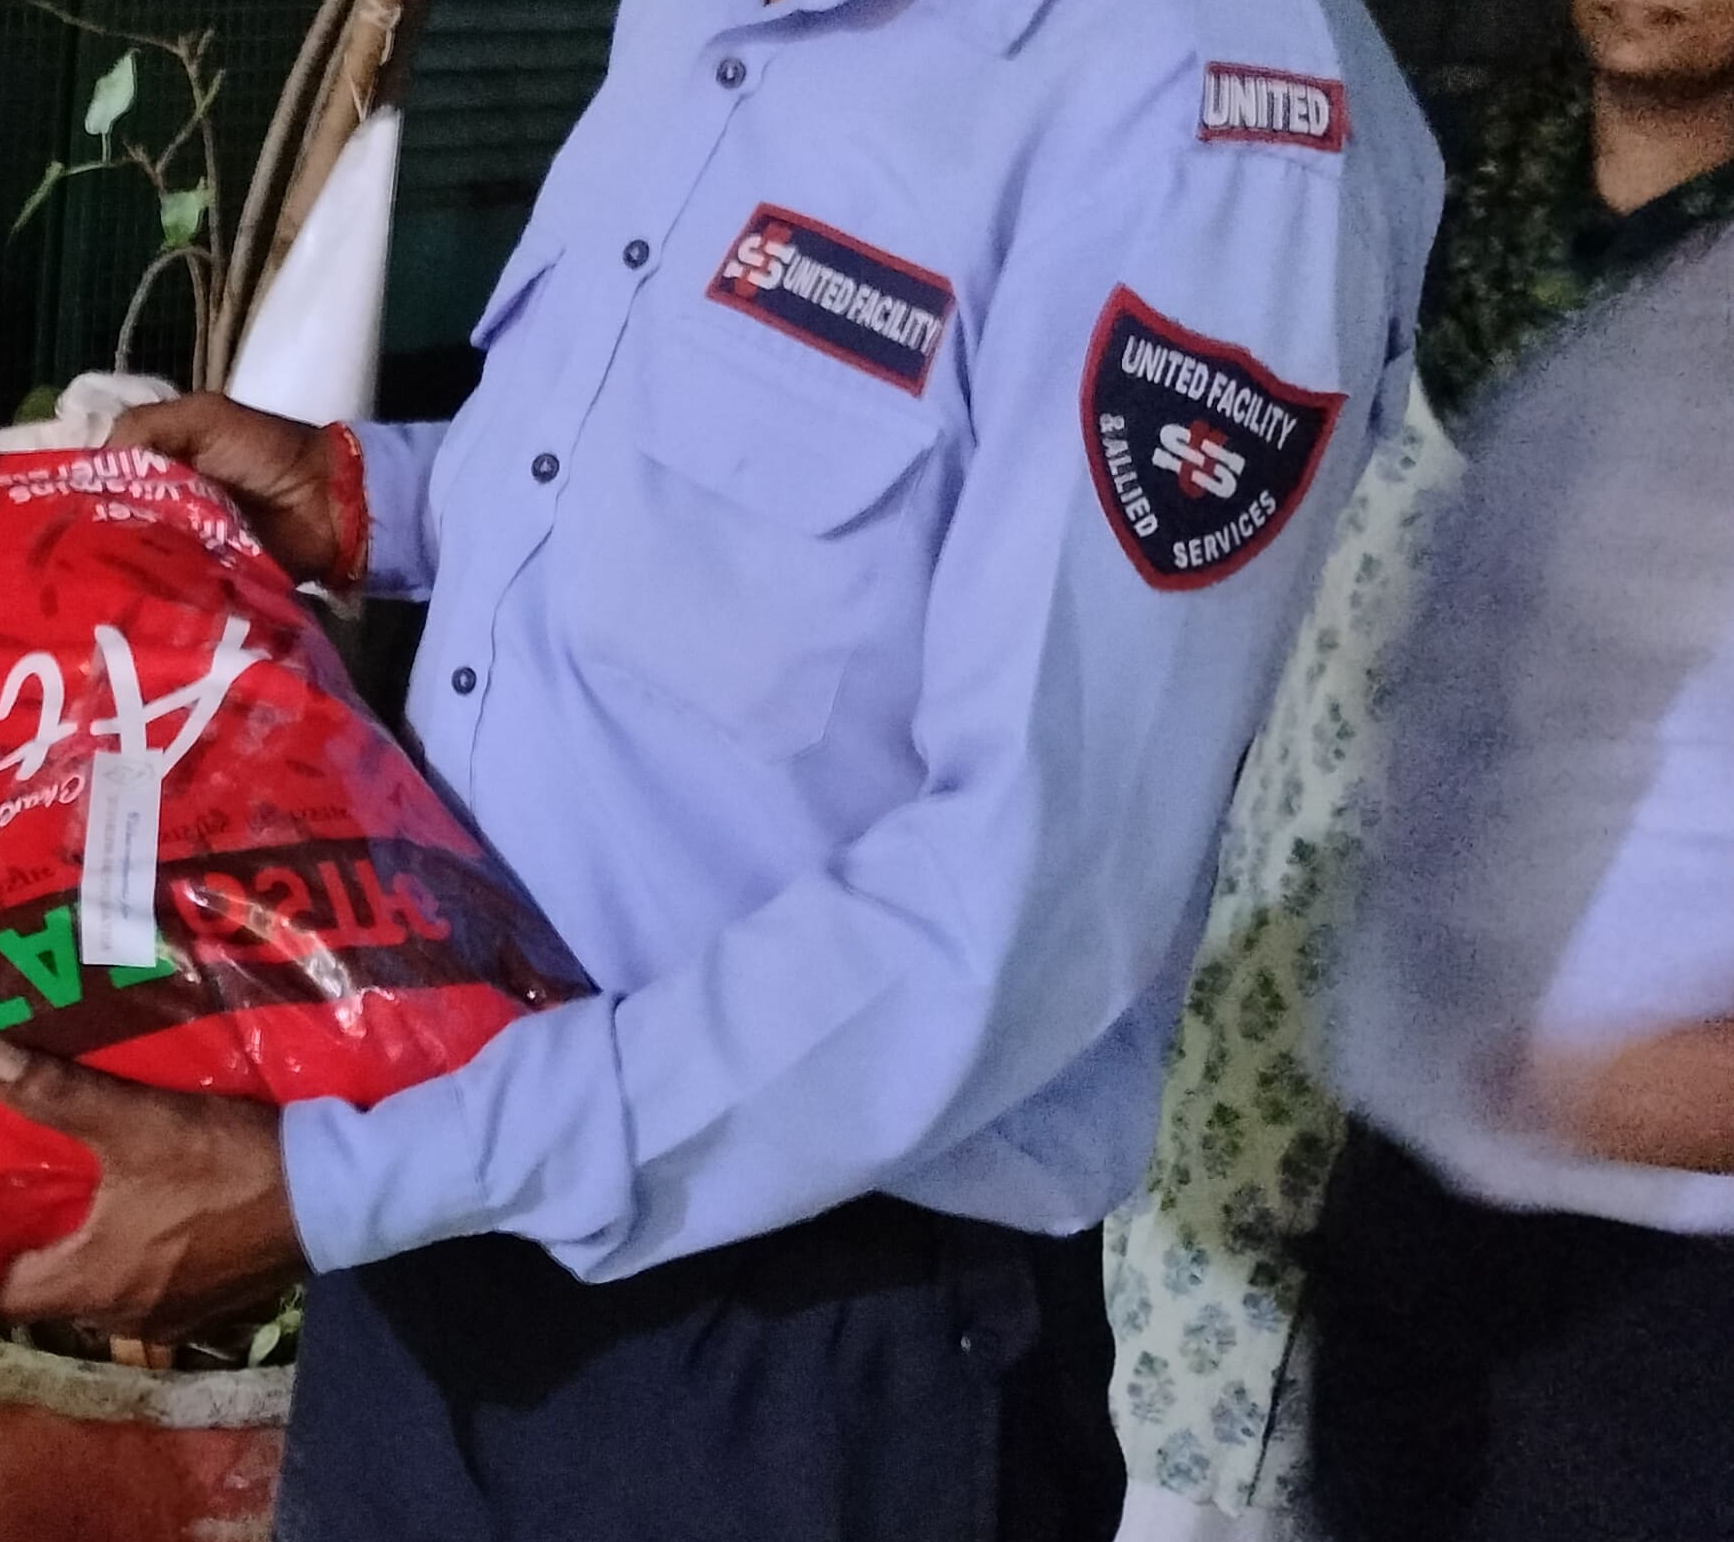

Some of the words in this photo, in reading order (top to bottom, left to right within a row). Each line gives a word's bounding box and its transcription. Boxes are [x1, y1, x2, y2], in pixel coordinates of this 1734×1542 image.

[1203, 73, 1330, 137] UNITED
[782, 254, 855, 317] UNITED
[846, 283, 942, 357] FACILITY
[1121, 334, 1209, 401] UNITED
[1206, 369, 1297, 451] FACILITY
[1102, 436, 1159, 539] ALLIED
[1171, 487, 1277, 570] SERVICES
[170, 858, 450, 966] भारत
